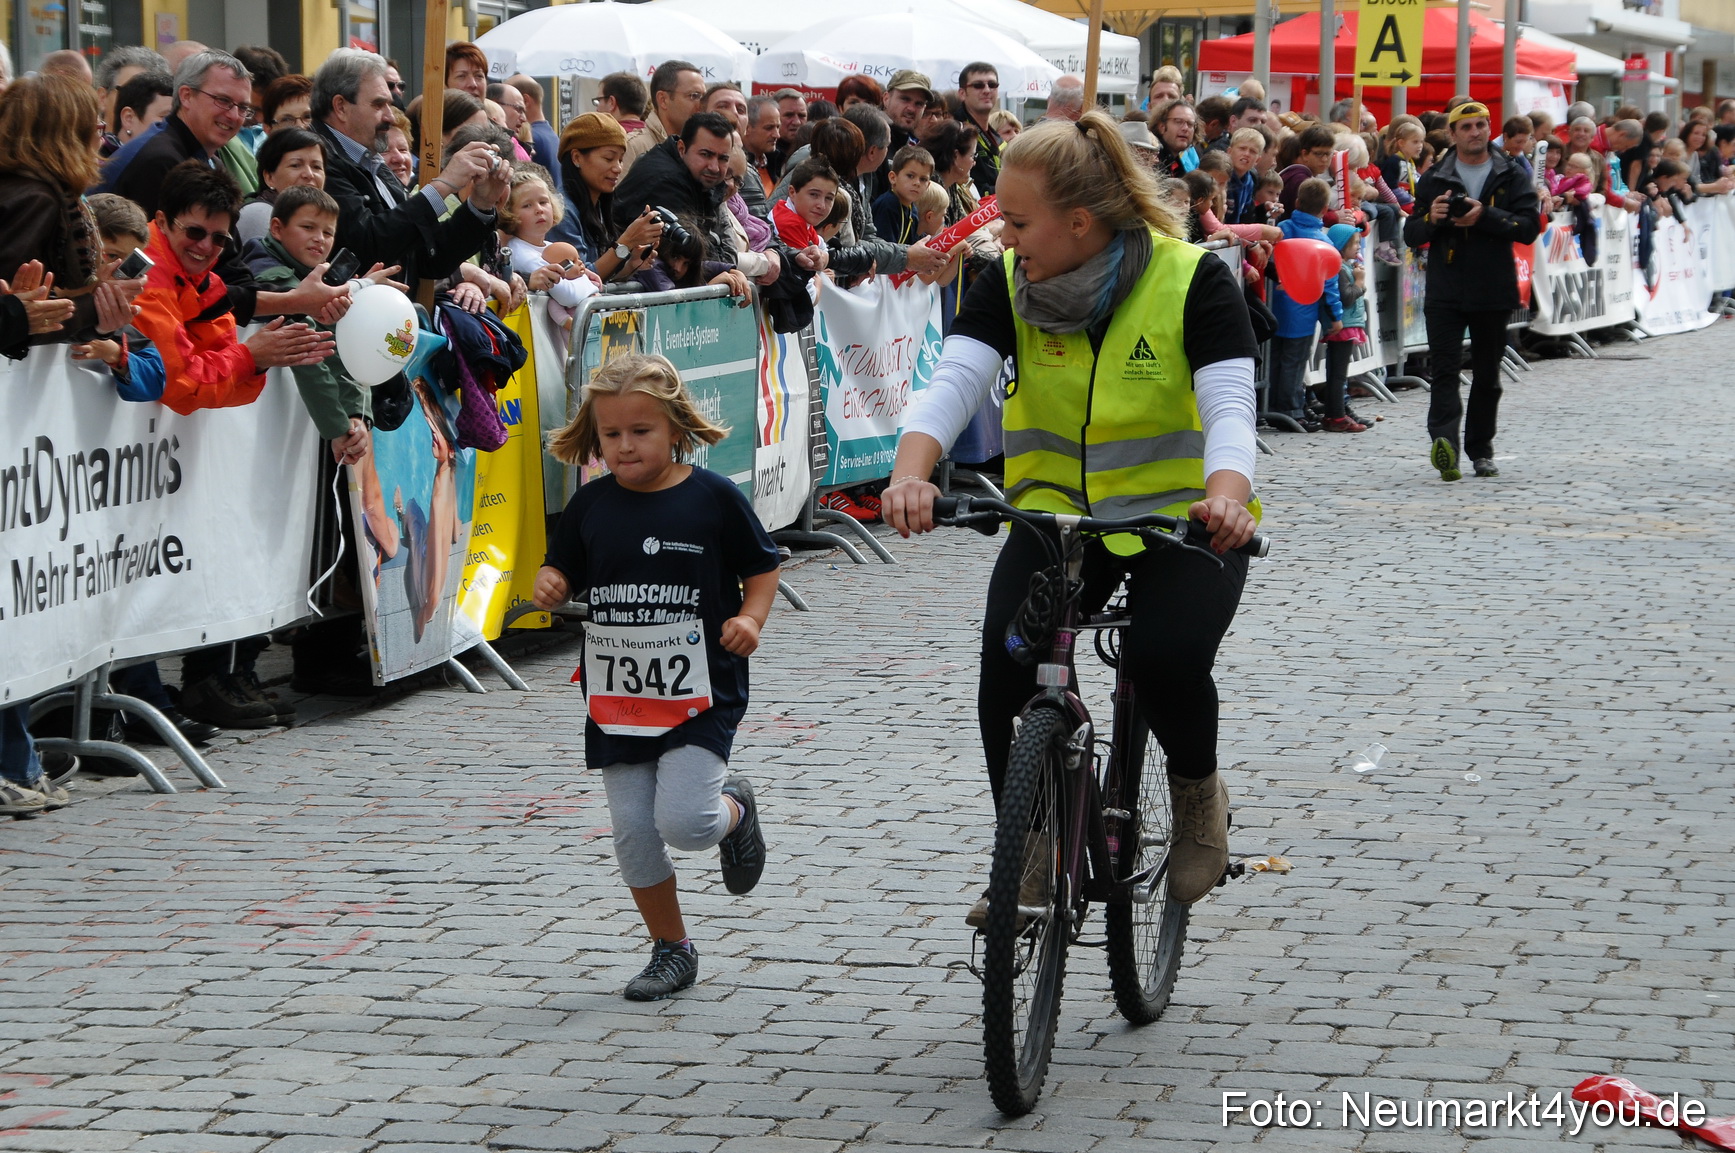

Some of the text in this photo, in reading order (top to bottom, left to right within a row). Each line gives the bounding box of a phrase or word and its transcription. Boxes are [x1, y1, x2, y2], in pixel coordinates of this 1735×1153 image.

[1369, 14, 1407, 63] A
[490, 61, 509, 75] BKK
[819, 55, 897, 77] Audi BKK
[930, 228, 962, 252] BKK
[665, 325, 720, 351] Event-Leit-Systeme
[0, 418, 182, 542] ntDynamics
[479, 491, 507, 509] atten
[11, 523, 192, 618] Mehr Fahrfreude.
[590, 583, 701, 606] GRUNDSCHULE
[592, 609, 608, 624] im
[610, 607, 635, 624] Haus
[586, 631, 682, 650] PARTL Neumarkt
[595, 653, 694, 697] 7342
[609, 698, 648, 724] Jule
